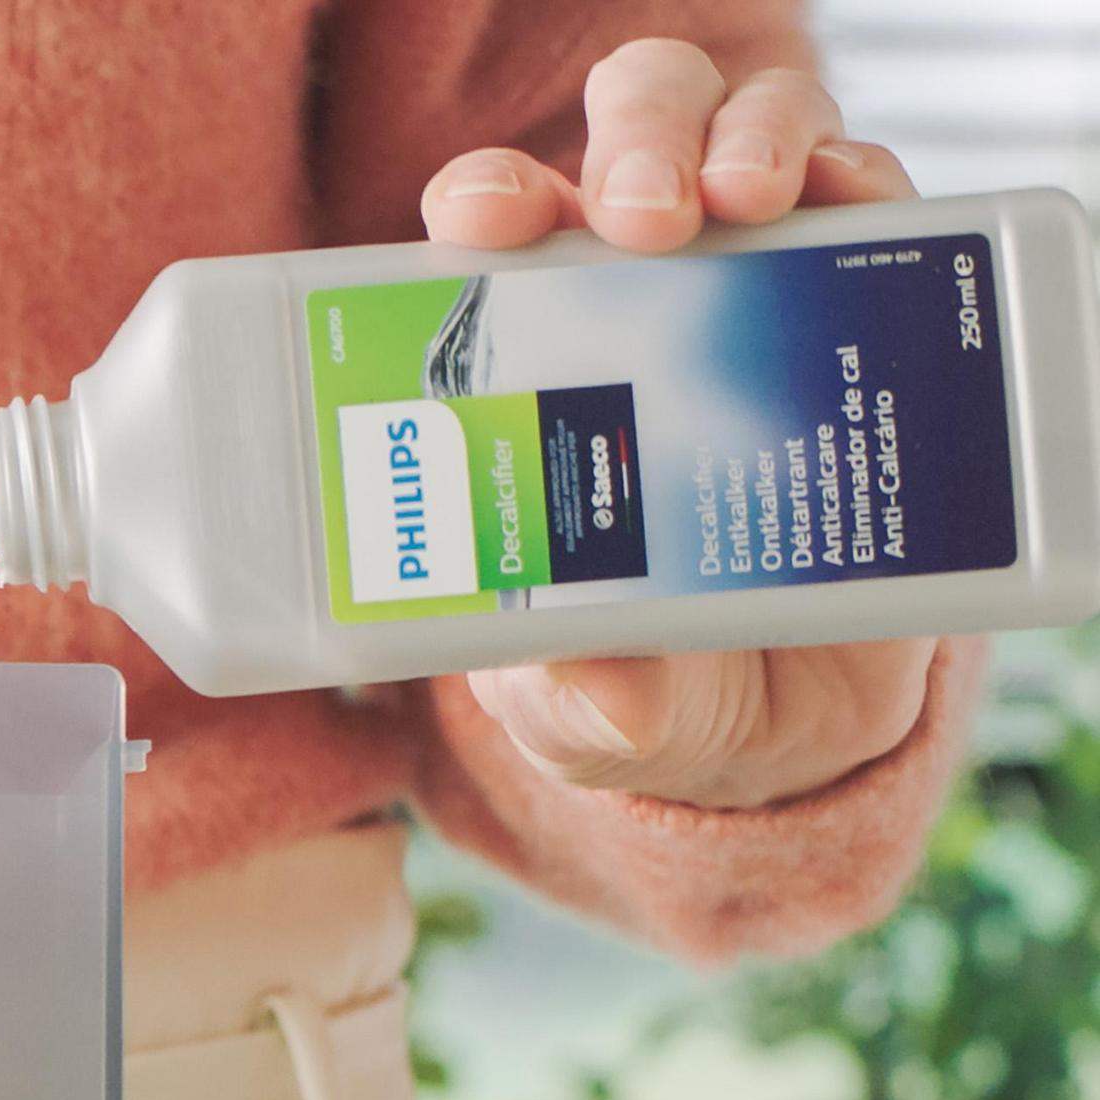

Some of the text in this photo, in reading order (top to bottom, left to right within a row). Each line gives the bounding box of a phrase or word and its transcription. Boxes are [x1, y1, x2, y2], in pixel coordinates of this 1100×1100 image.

[387, 418, 429, 581] PHILIPS
[491, 437, 524, 574] Decalcifier
[590, 434, 613, 507] Saeco
[725, 457, 751, 574] Entkalker
[755, 450, 783, 572] Ontkalker
[784, 436, 814, 569] Détartrant
[816, 423, 845, 566] Anticalcare
[835, 345, 875, 564] Eliminador de cal
[872, 389, 905, 559] Anti-Calcário
